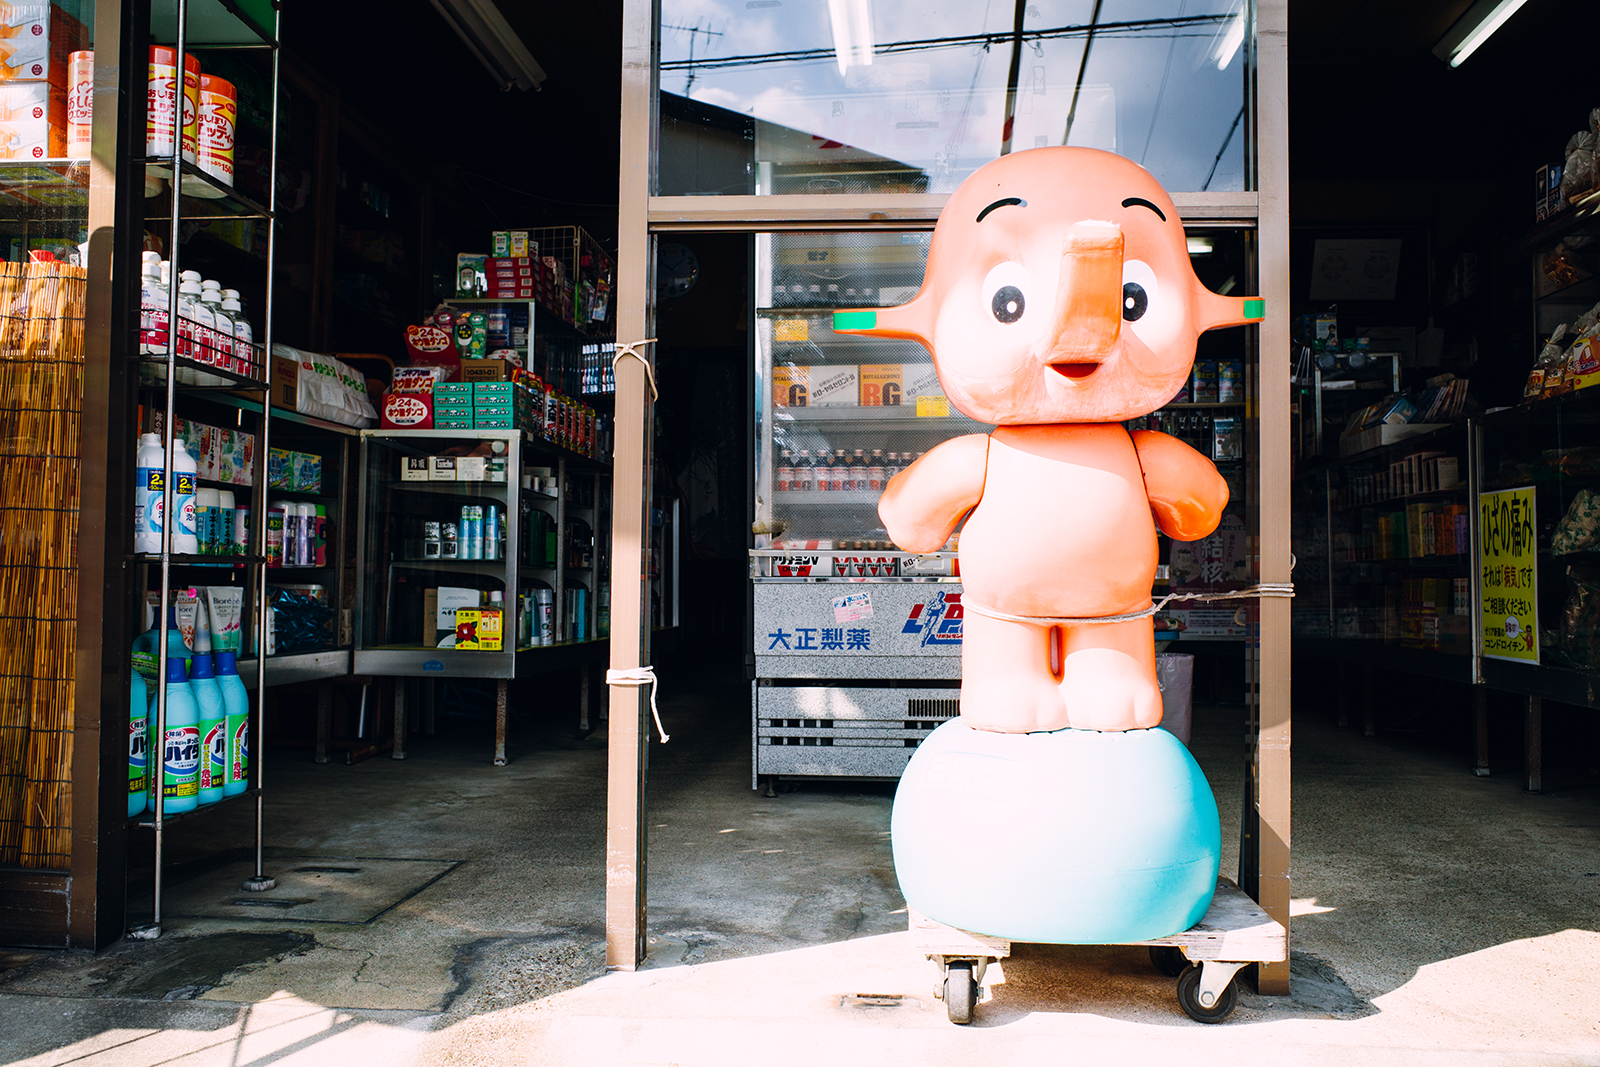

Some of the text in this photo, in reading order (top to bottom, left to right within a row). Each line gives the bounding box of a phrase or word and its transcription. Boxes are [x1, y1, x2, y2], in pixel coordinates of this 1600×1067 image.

[420, 329, 434, 337] 24
[397, 399, 411, 407] 24
[862, 382, 901, 406] RG
[1483, 492, 1533, 557] ひざの痛み
[1200, 535, 1224, 584] 結核
[1483, 564, 1533, 589] それは「病気」です
[1483, 597, 1531, 616] ご相談ください
[768, 628, 870, 650] 大正製薬
[1485, 638, 1525, 652] コンドロイチン
